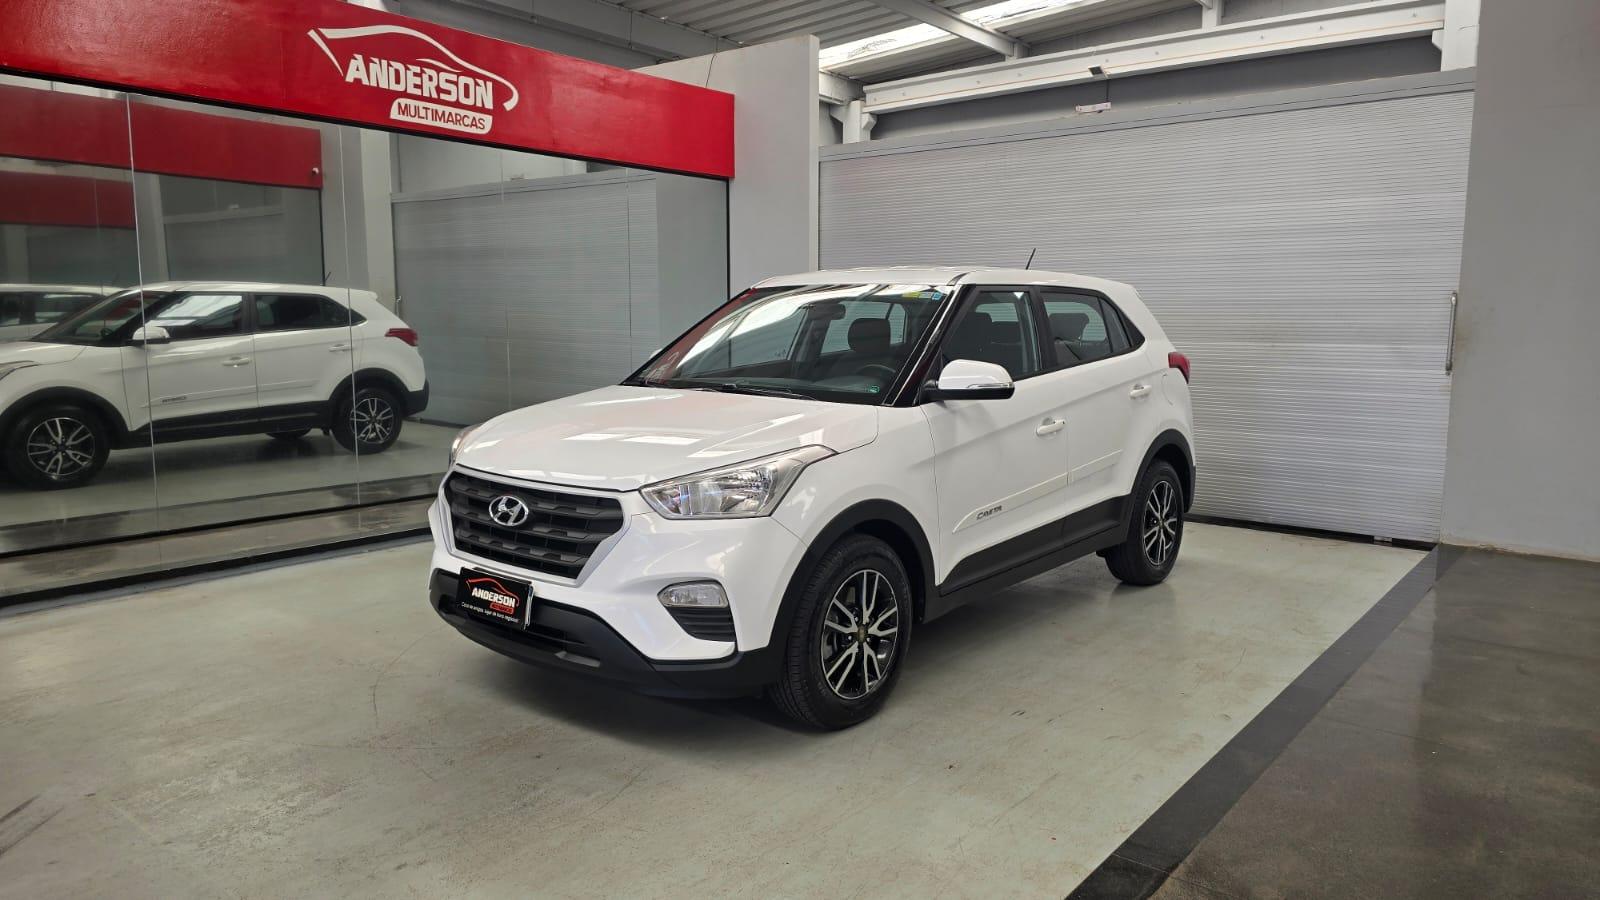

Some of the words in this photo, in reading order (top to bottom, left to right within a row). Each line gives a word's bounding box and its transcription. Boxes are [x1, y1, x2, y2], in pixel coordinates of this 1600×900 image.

[345, 53, 494, 110] ANDERSON
[397, 102, 486, 130] MULTIMARCAS
[471, 587, 516, 608] ANDERSON
